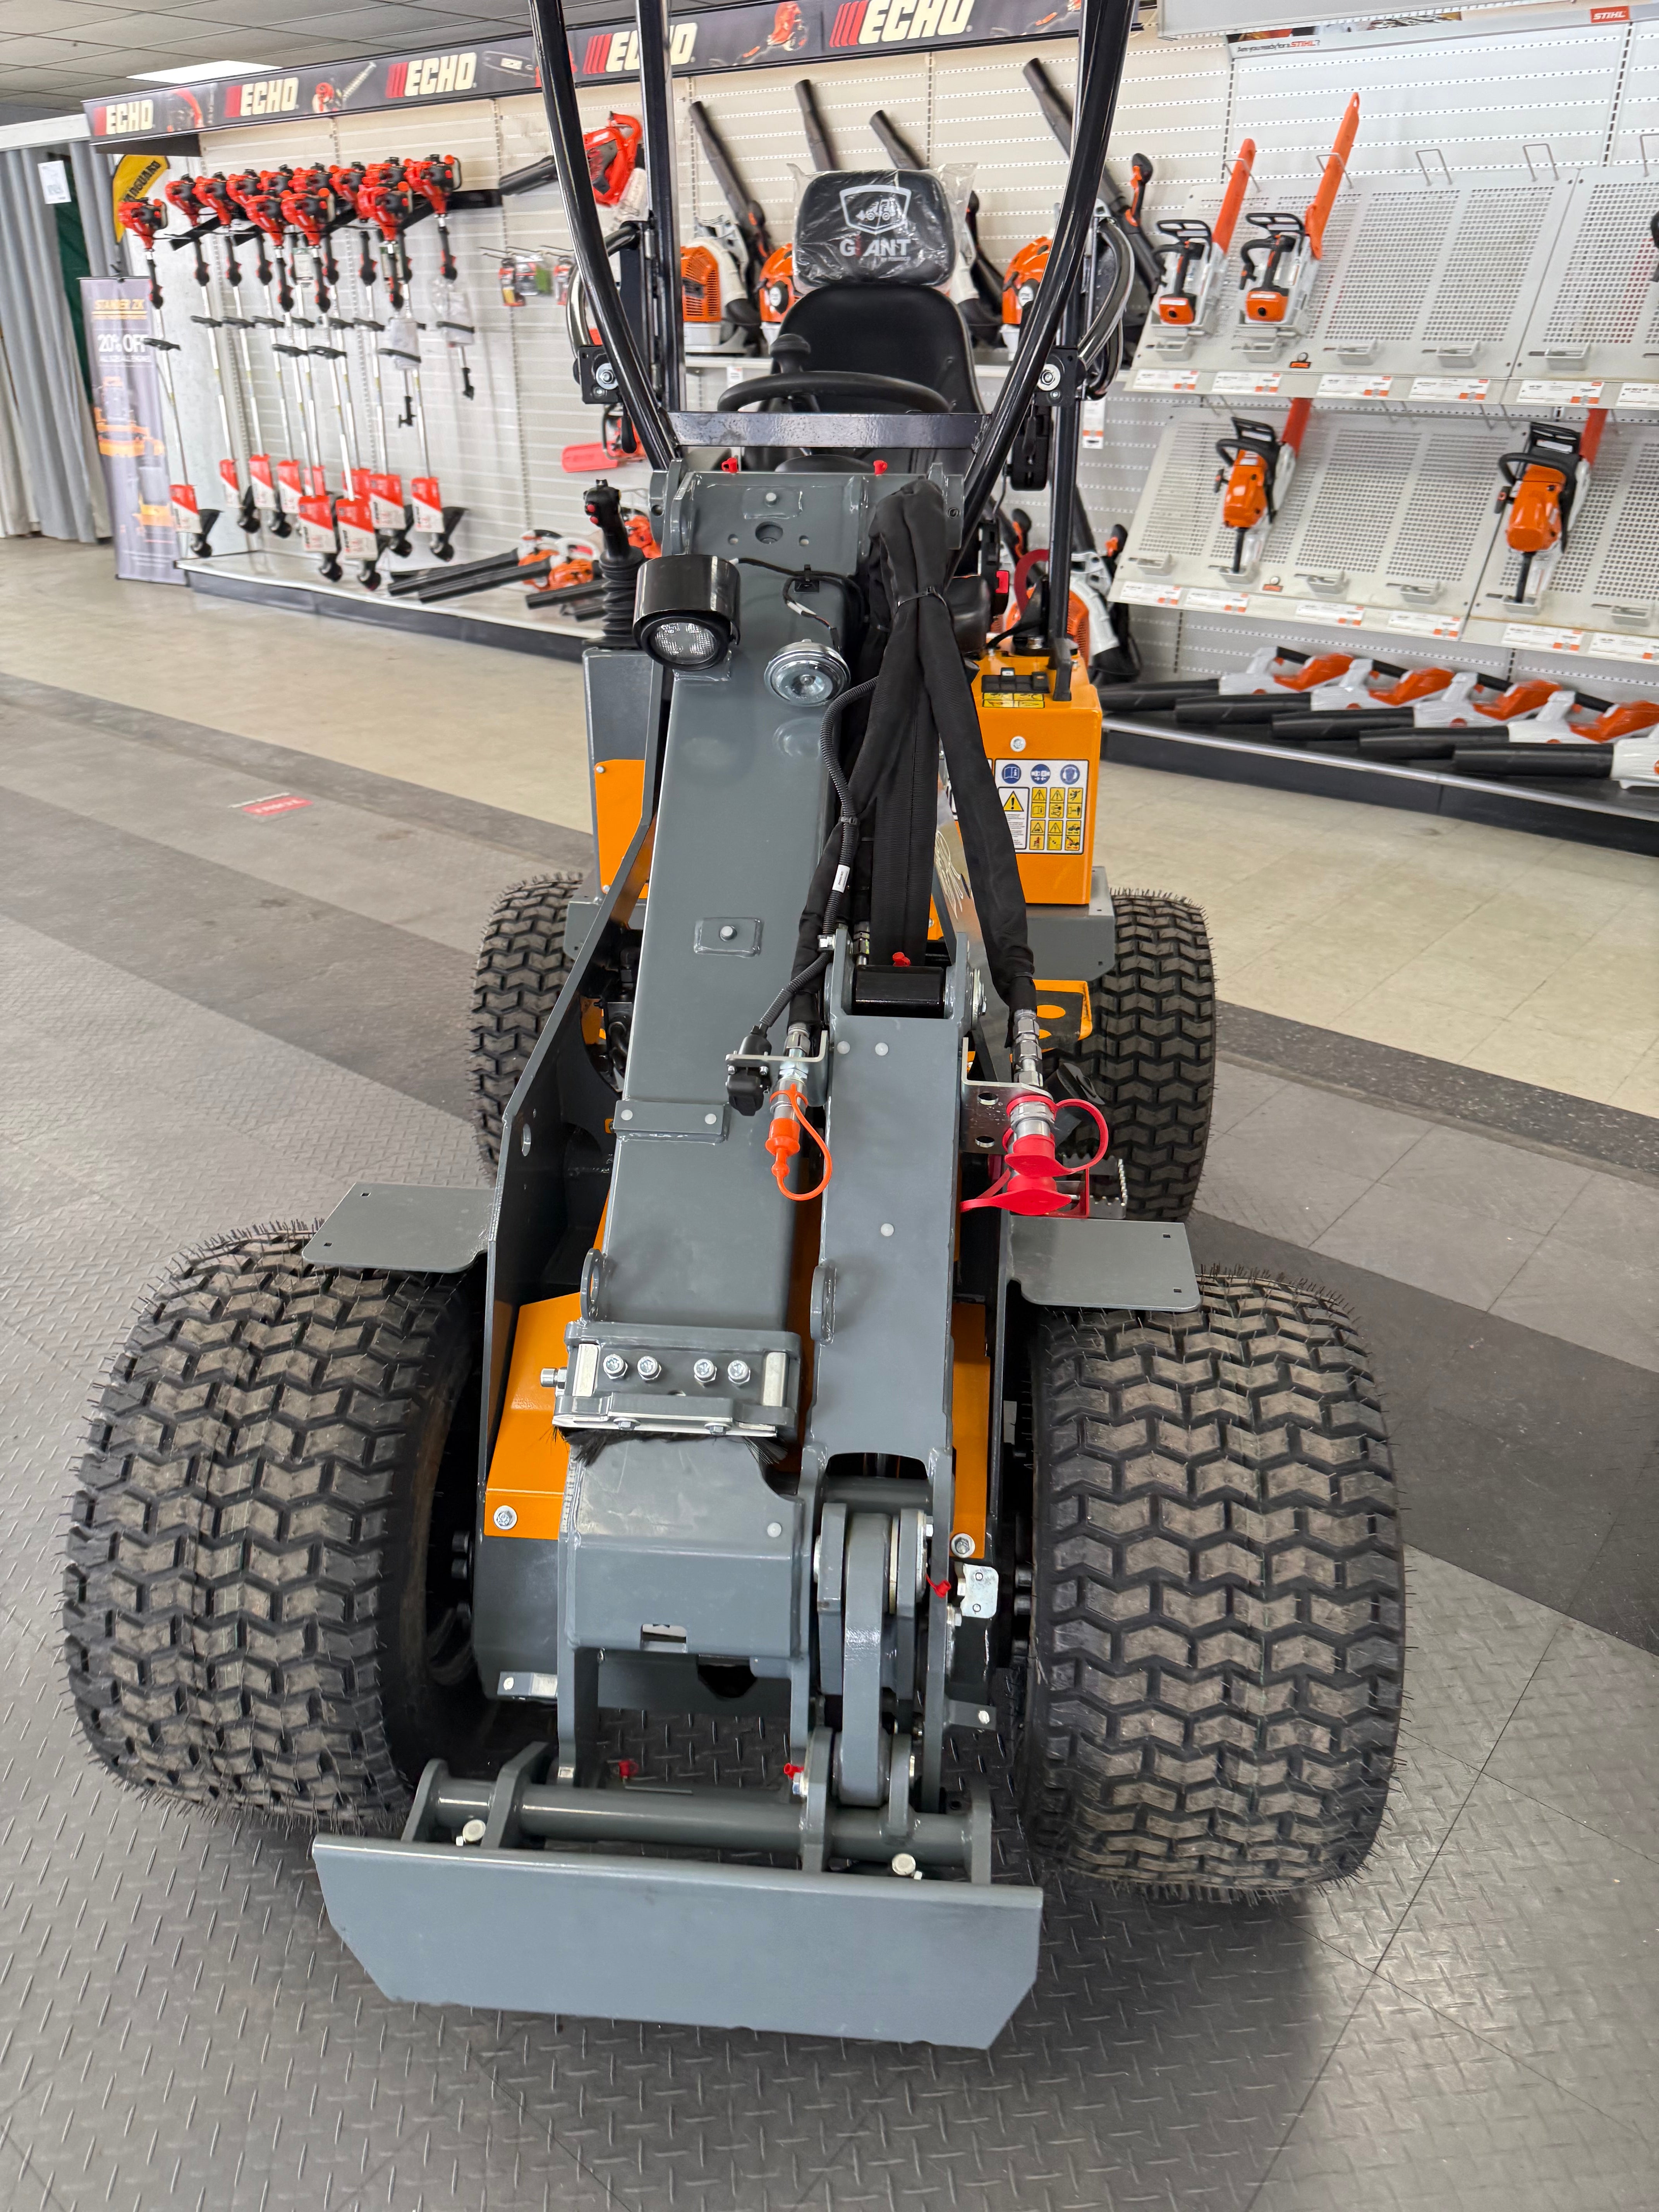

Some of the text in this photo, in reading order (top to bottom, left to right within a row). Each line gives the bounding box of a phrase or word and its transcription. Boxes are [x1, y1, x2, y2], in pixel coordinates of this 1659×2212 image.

[859, 0, 974, 44] ECHO
[1593, 11, 1626, 20] STIHL
[606, 22, 697, 72] ECO
[404, 52, 477, 96] ECHO
[240, 77, 299, 116] ECHO
[106, 99, 153, 135] ECHO
[840, 235, 911, 257] GIANT
[97, 334, 148, 352] 20% OFF
